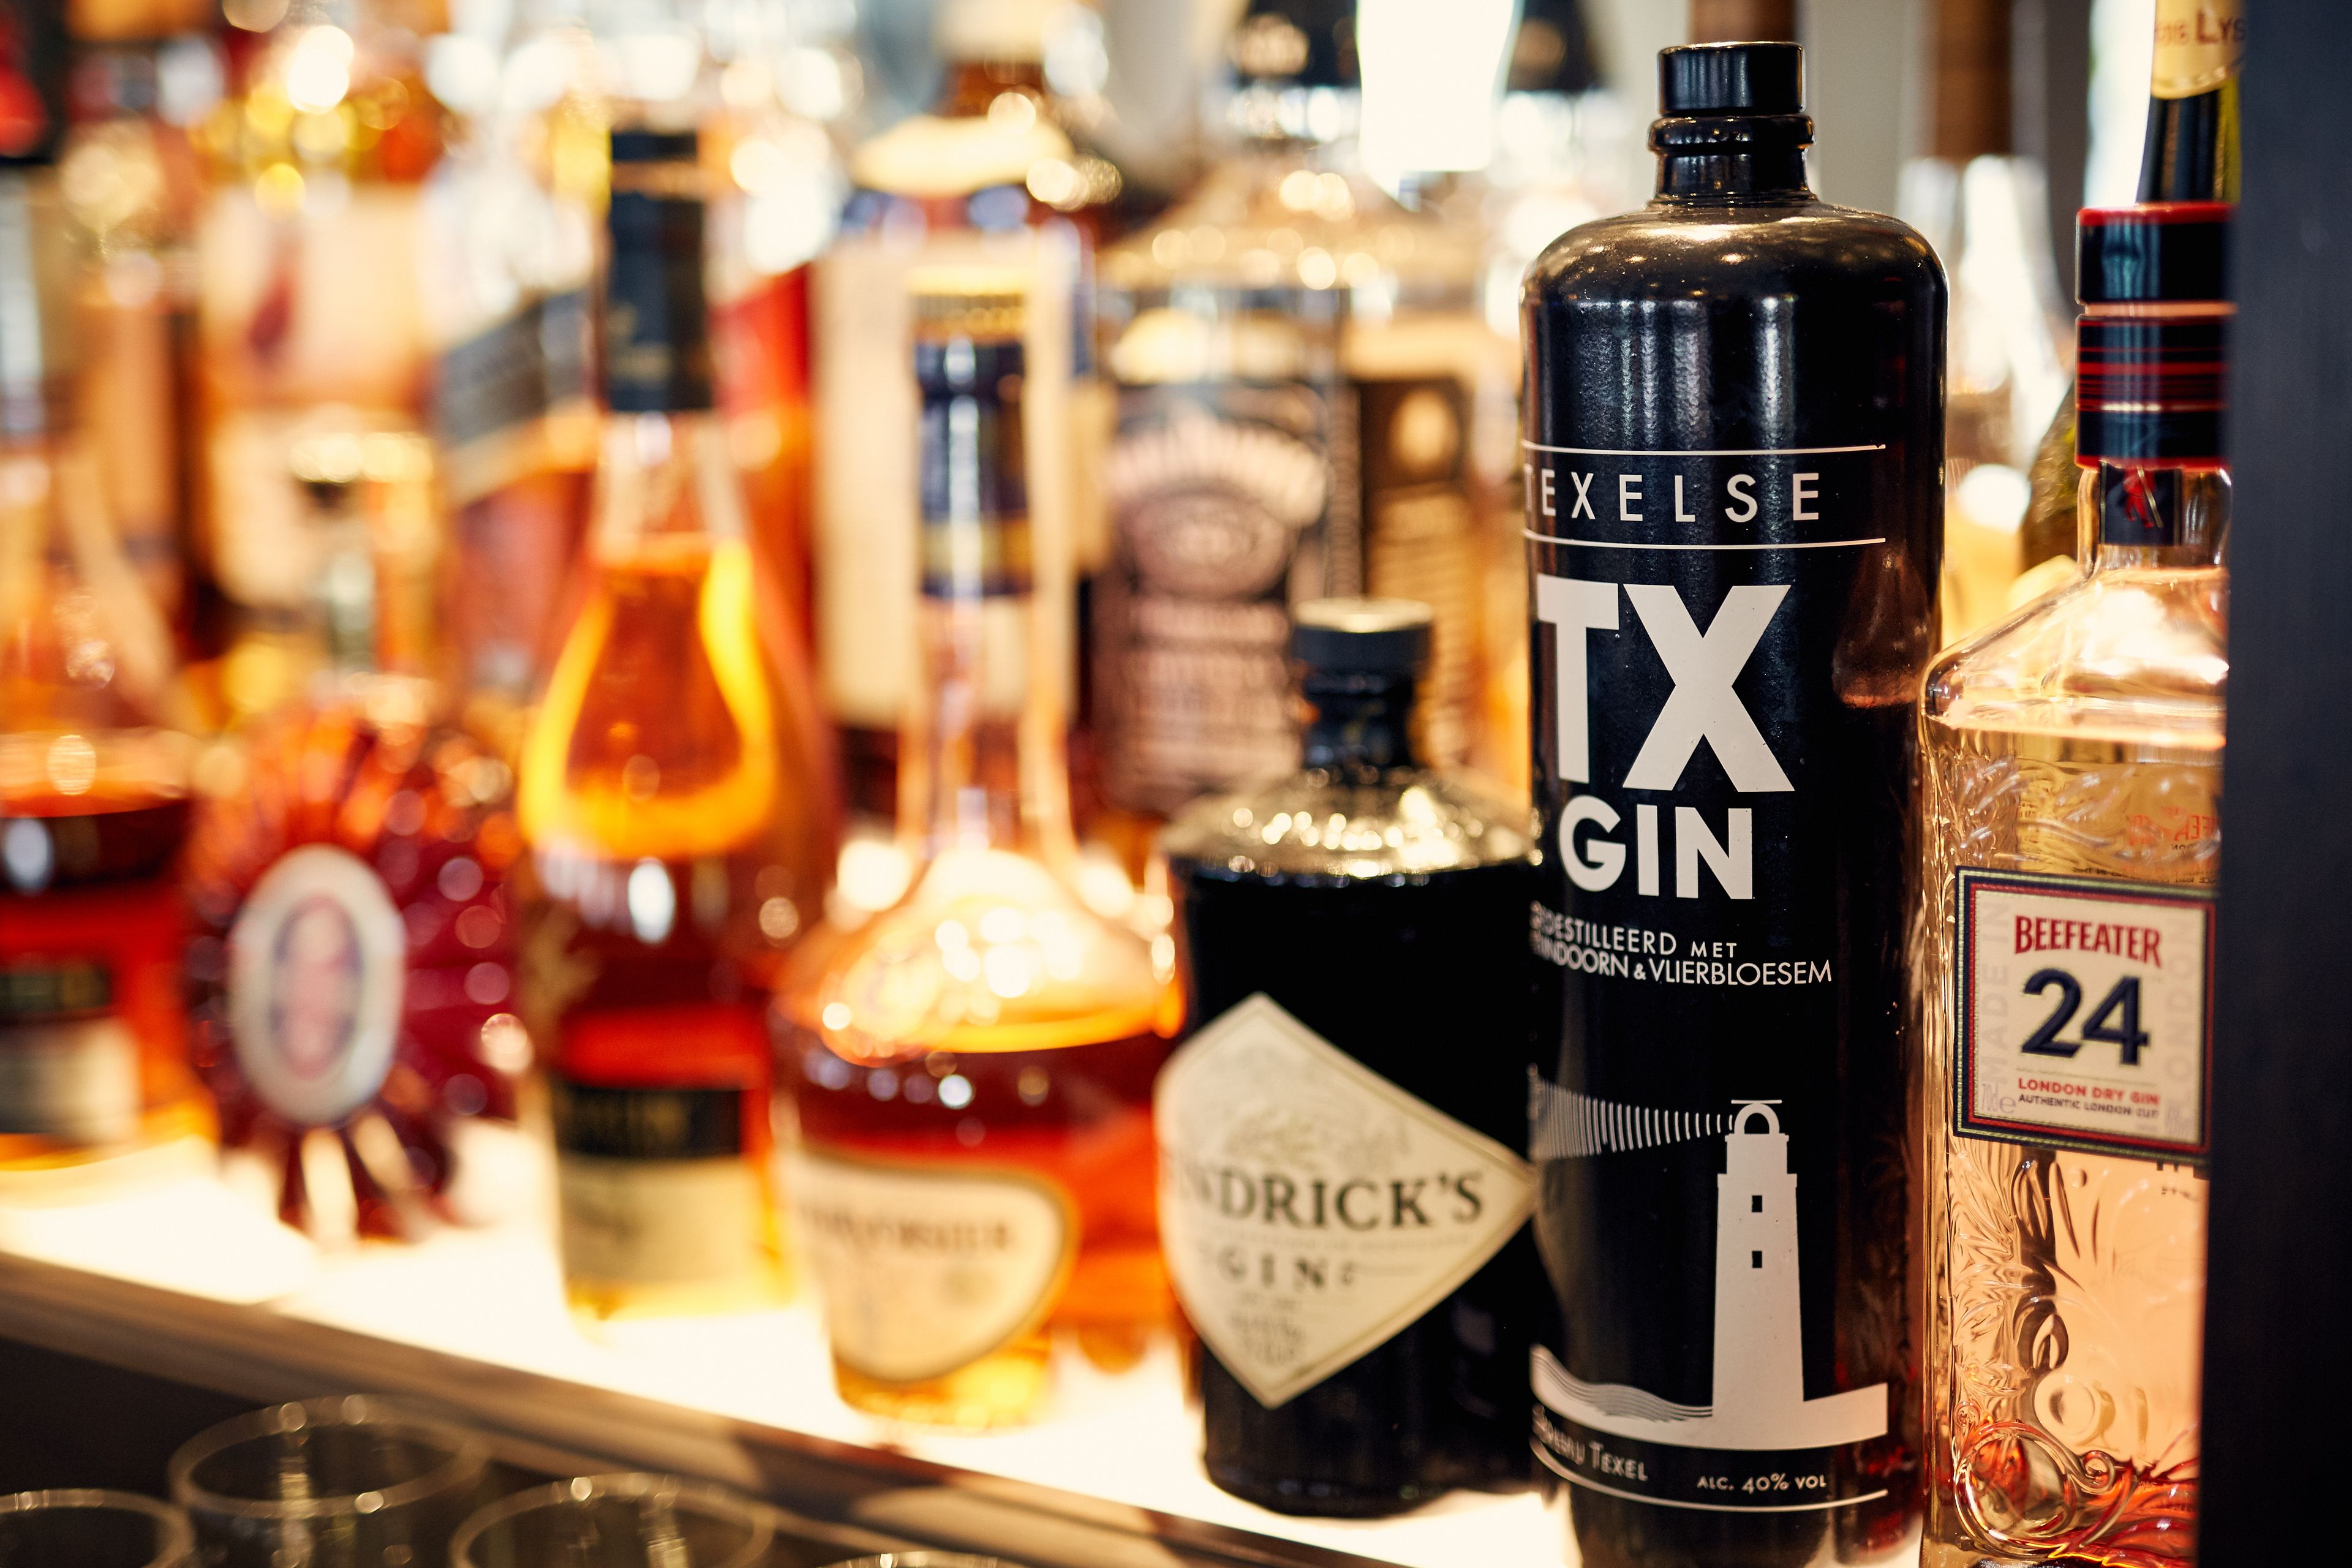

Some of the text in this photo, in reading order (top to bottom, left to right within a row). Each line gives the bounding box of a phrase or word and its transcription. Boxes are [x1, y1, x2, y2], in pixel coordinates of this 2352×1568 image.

[1537, 575, 1795, 792] TX
[1559, 795, 1752, 899] GIN
[1691, 941, 1737, 958] MET
[2014, 915, 2162, 969] BEEFEATER
[1634, 963, 1646, 980] &
[1648, 957, 1832, 986] VLIERBLOESEM
[2021, 968, 2150, 1066] 24
[2018, 1077, 2160, 1106] LONDON DRY GIN
[2018, 1093, 2080, 1109] AUTHENTIC
[2083, 1102, 2131, 1115] LONDON
[1177, 1159, 1483, 1231] NDRICK'S
[1741, 1472, 1790, 1494] 40%
[1794, 1474, 1827, 1490] VOL
